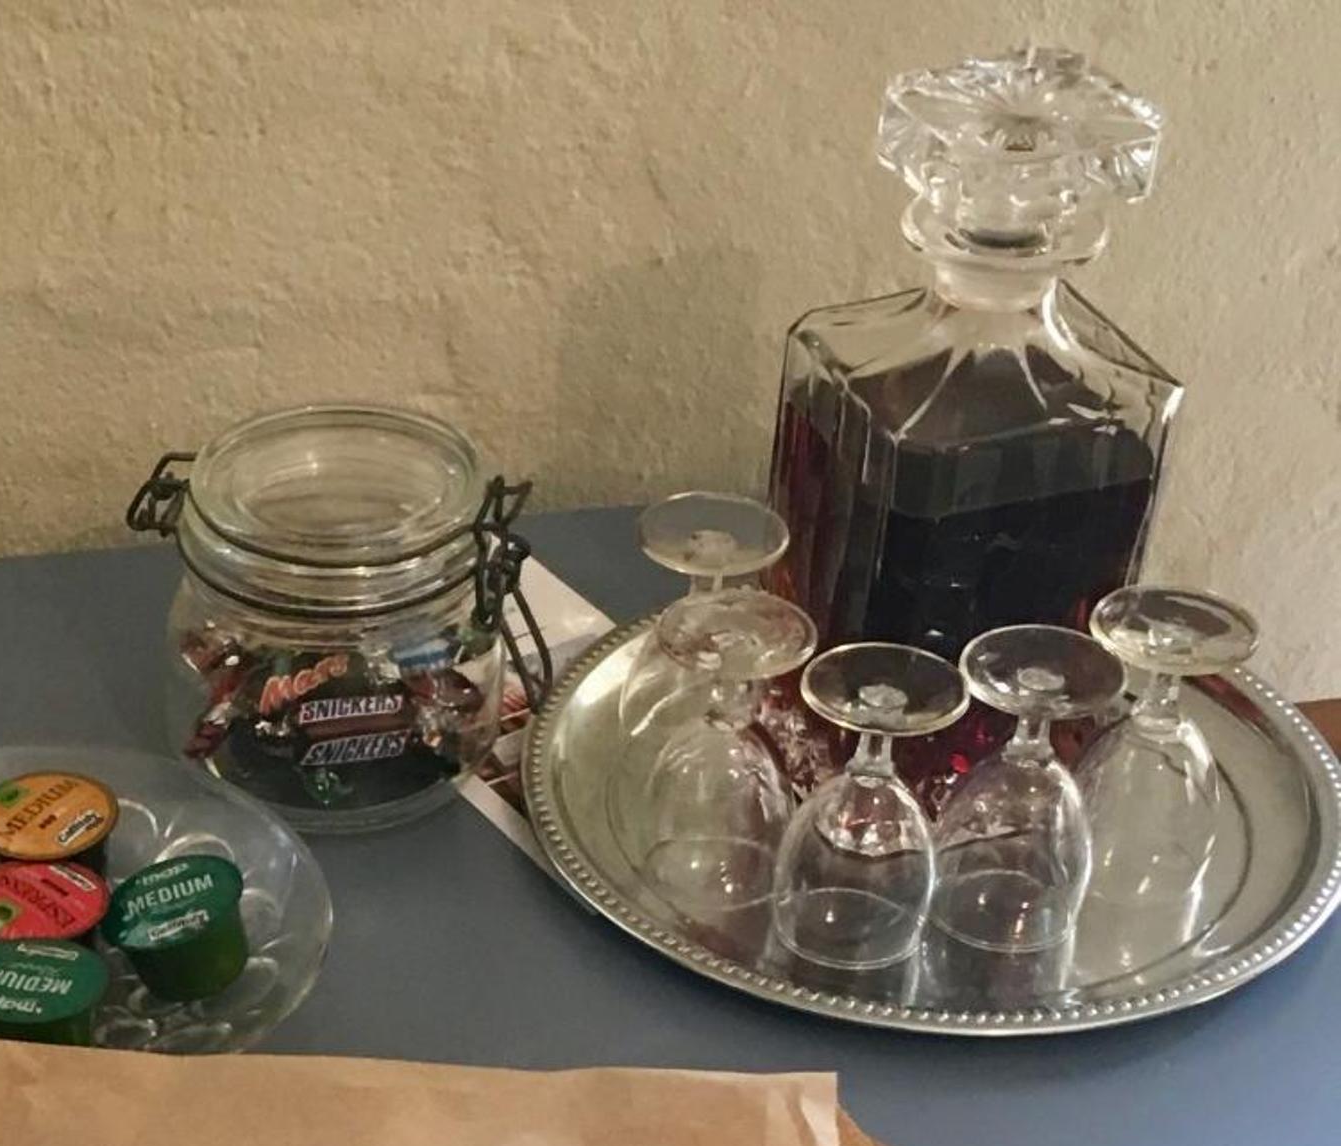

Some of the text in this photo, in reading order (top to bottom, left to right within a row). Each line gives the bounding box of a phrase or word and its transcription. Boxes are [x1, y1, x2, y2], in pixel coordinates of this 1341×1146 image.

[300, 695, 402, 724] SNICKERS
[302, 729, 409, 766] SNICKERS
[122, 873, 214, 922] MEDIUM
